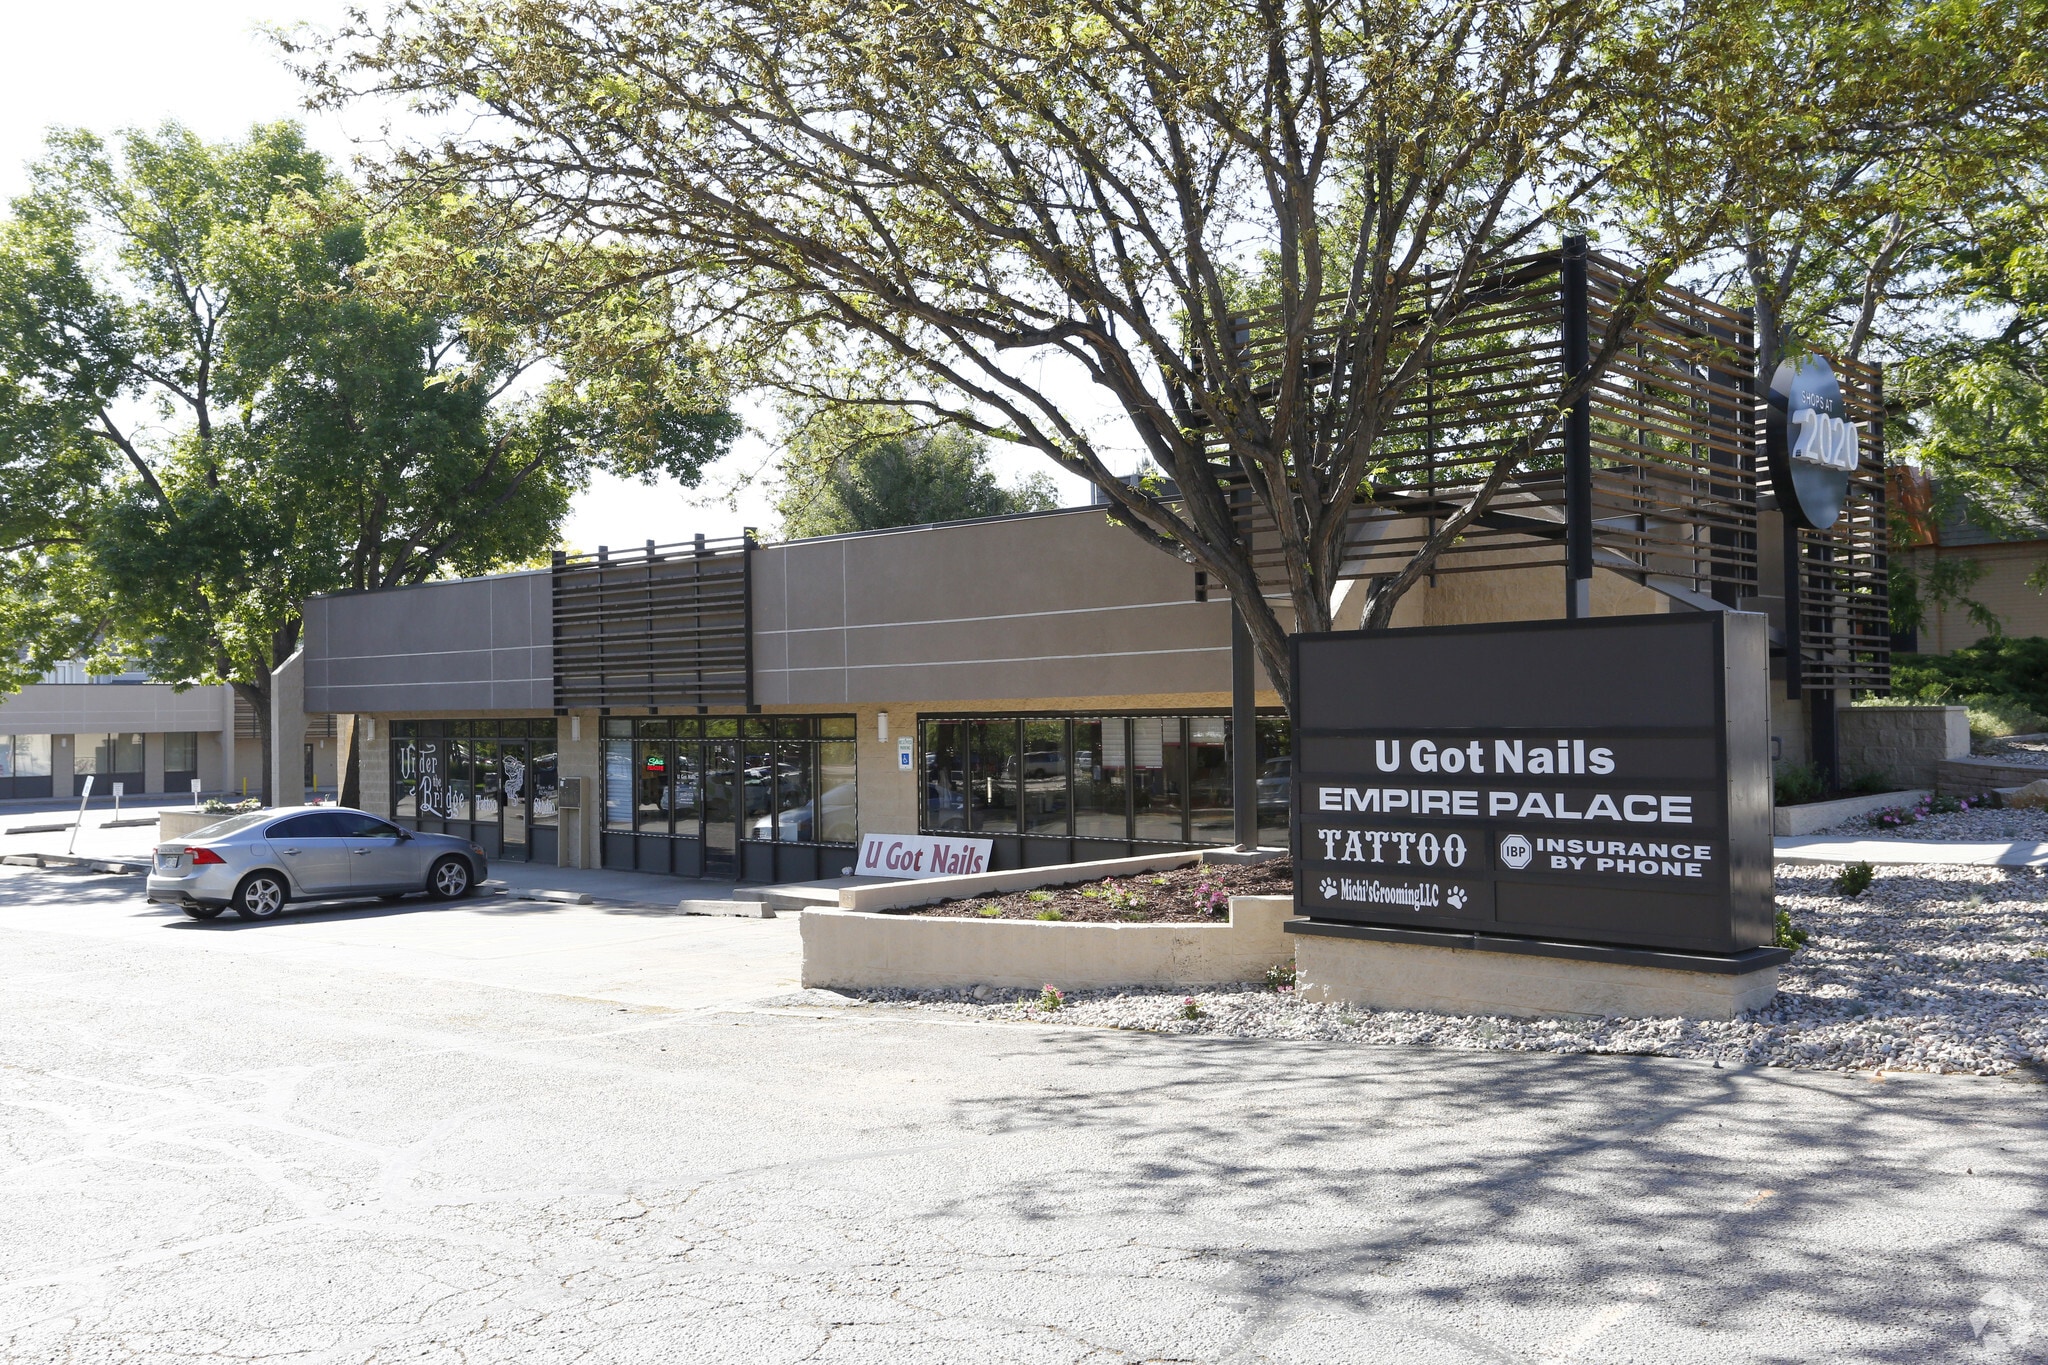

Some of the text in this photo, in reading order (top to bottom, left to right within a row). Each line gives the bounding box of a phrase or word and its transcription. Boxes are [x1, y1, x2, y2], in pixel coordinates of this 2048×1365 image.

[1801, 391, 1833, 412] SHOPS AT
[1792, 408, 1859, 471] 2020
[1375, 740, 1616, 775] U Got Nails
[409, 776, 464, 819] Bridge
[476, 795, 497, 812] Tattoo
[1319, 787, 1693, 824] EMPIRE PALACE
[865, 841, 983, 875] U Got Nails
[1318, 829, 1467, 867] TATTOO
[1506, 846, 1526, 857] IBP
[1536, 838, 1712, 860] INSURANCE
[1550, 855, 1702, 877] BY PHONE
[1340, 878, 1439, 912] Michi'sGroomingLLC
